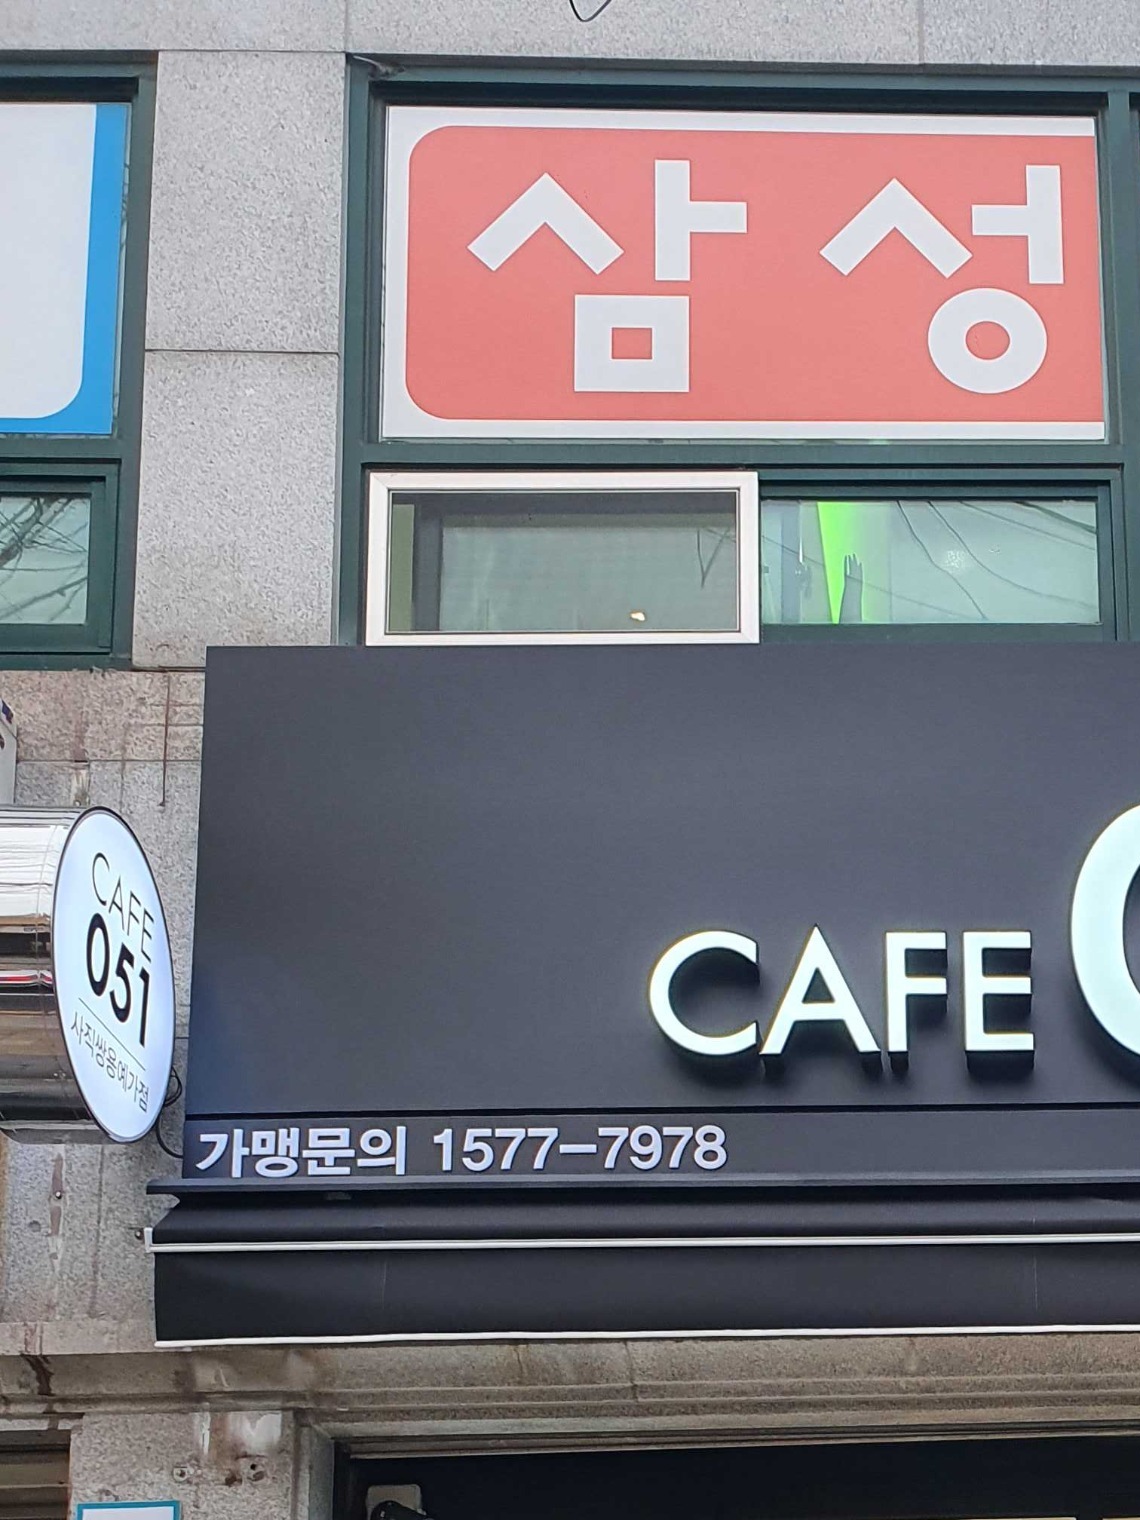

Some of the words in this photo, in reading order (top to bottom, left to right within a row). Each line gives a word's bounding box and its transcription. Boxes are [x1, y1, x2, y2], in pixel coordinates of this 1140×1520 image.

[91, 852, 154, 964] CAFE
[86, 912, 151, 1048] 051
[649, 925, 1034, 1056] CAFE
[71, 1010, 150, 1113] 사직쌍용예가점
[195, 1126, 406, 1178] 가맹문의
[433, 1124, 728, 1172] 1577-7978
